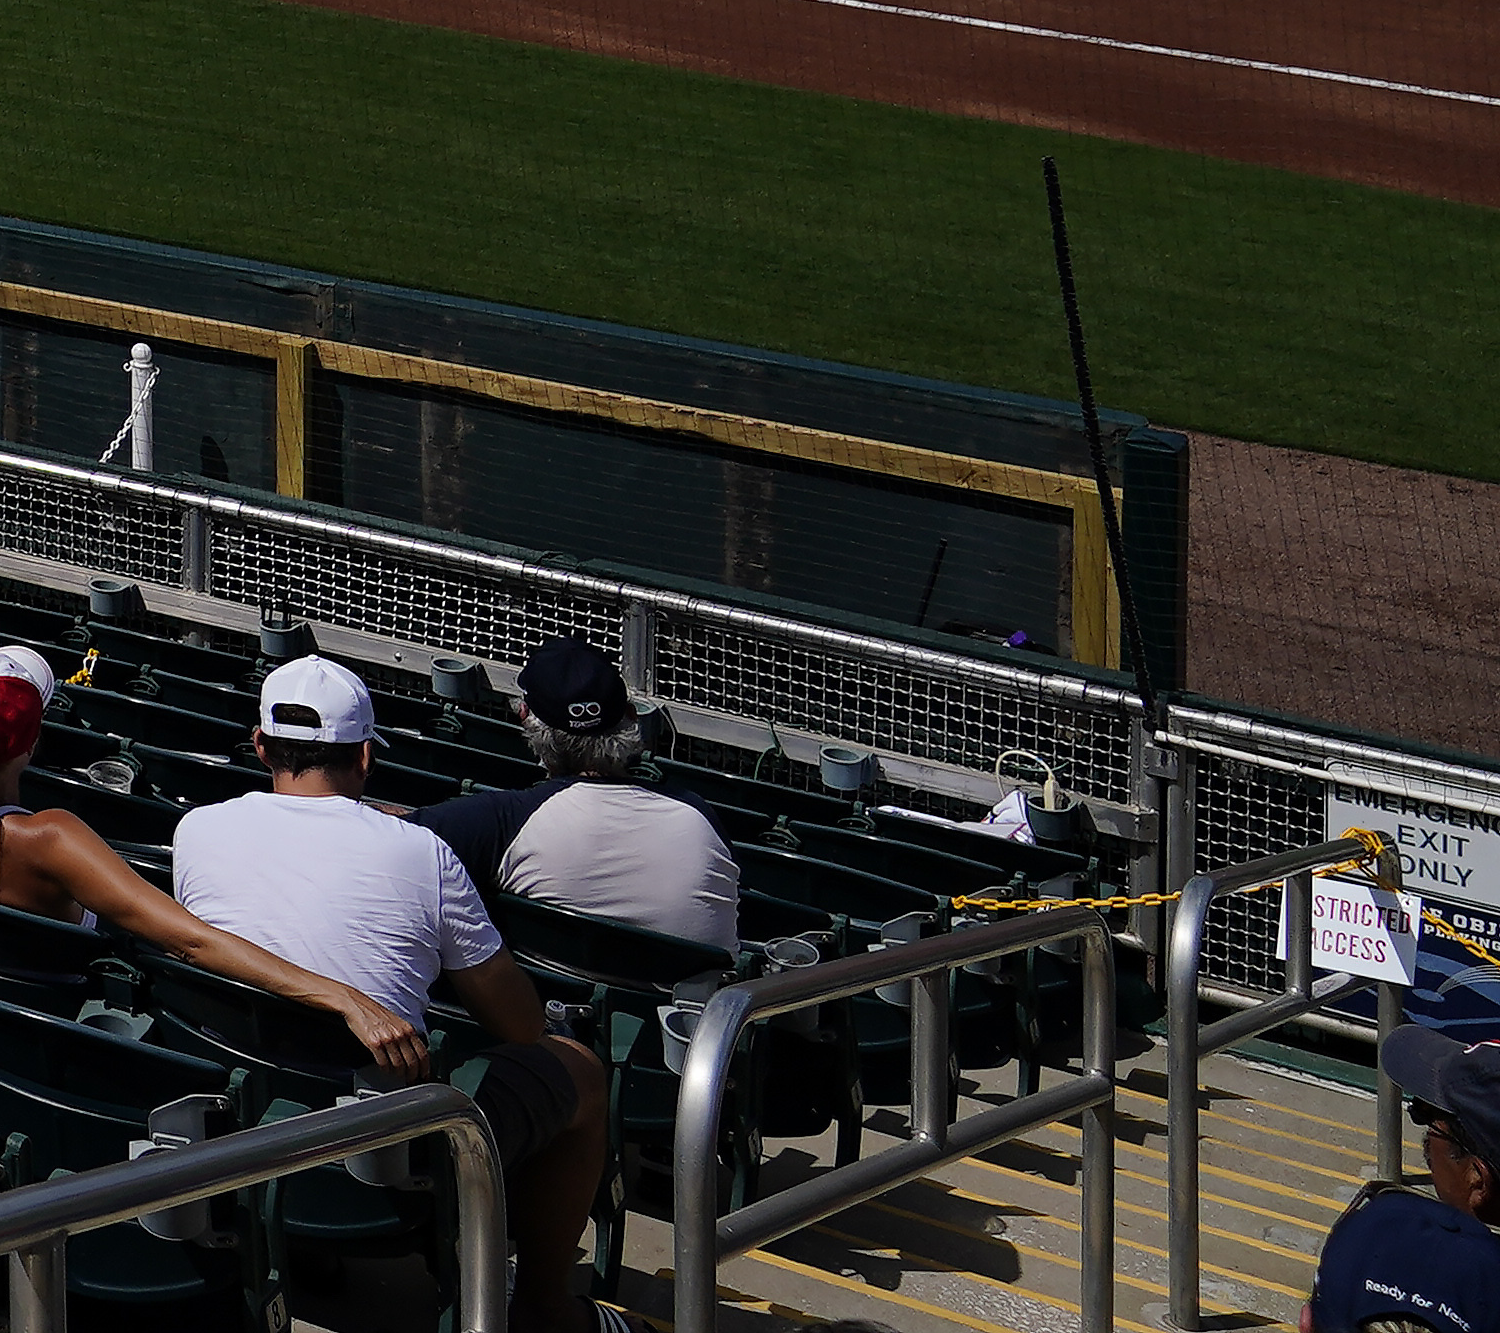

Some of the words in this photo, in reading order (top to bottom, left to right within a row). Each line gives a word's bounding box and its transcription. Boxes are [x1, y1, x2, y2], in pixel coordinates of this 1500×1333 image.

[1396, 823, 1470, 868] EXIT
[1376, 853, 1473, 887] ONLY
[1313, 894, 1411, 935] STRICTED
[1453, 913, 1500, 939] OBJ
[1364, 1279, 1408, 1302] Ready
[1411, 1293, 1435, 1309] for
